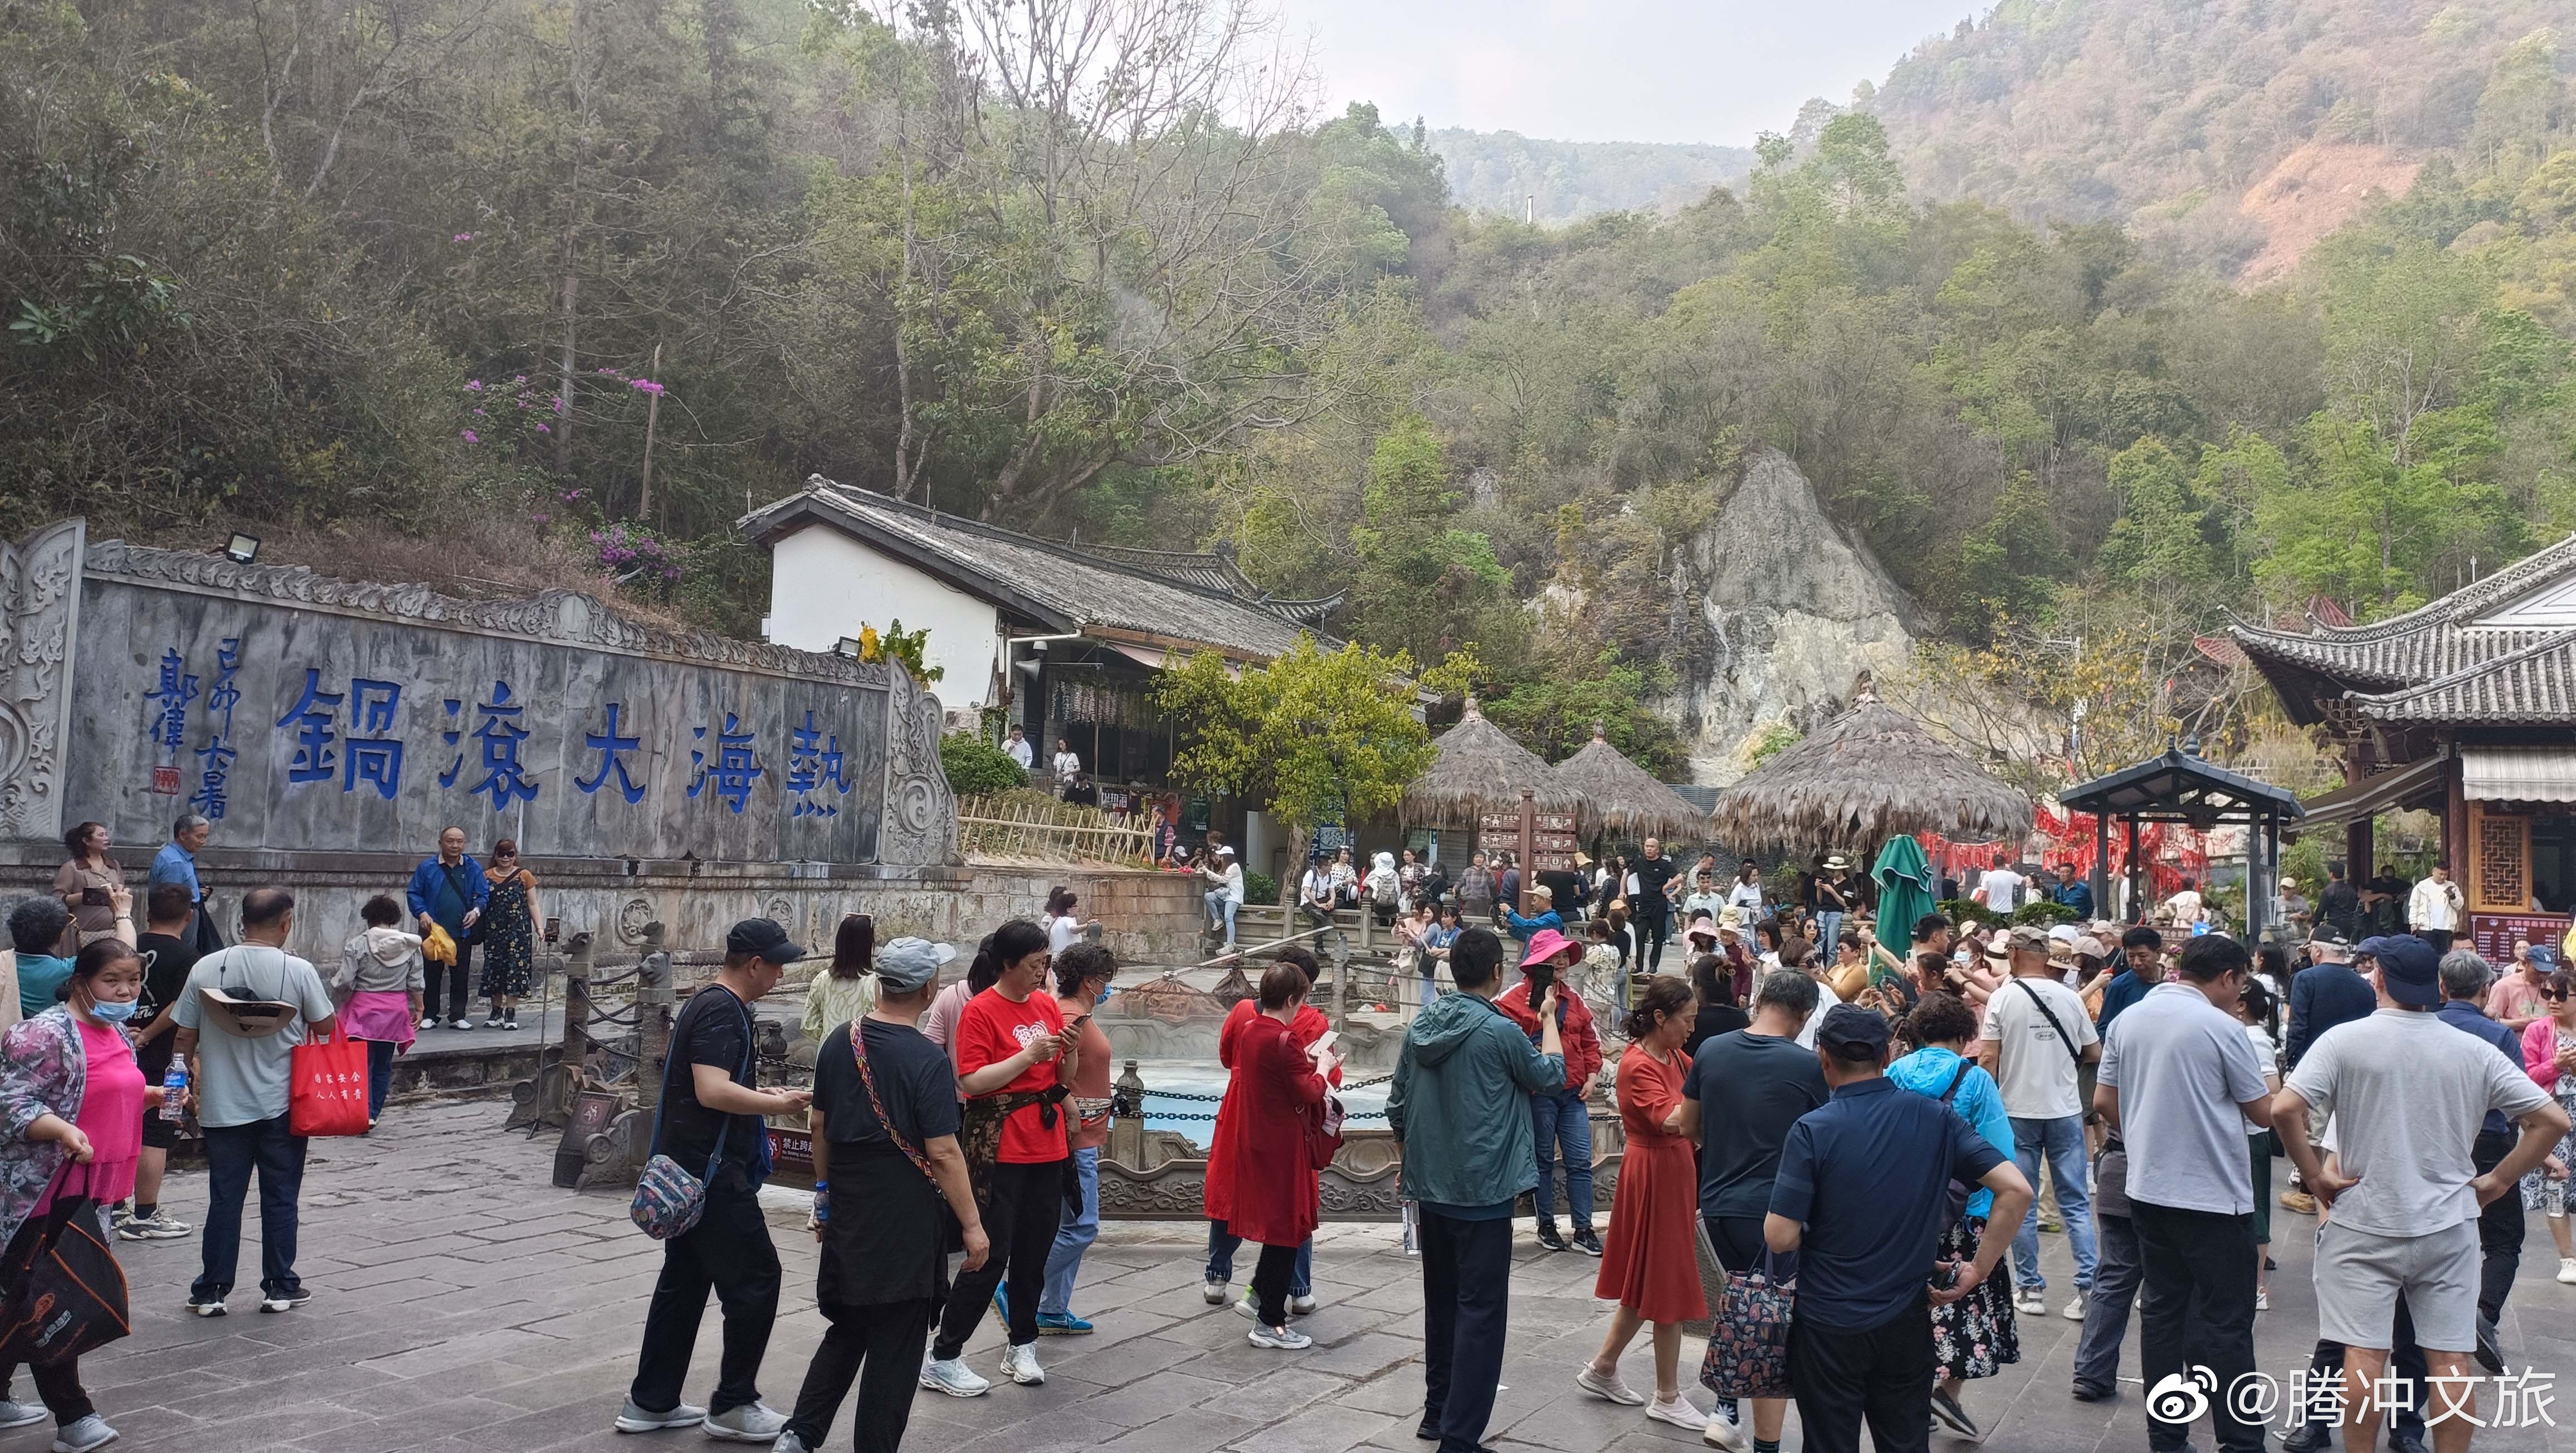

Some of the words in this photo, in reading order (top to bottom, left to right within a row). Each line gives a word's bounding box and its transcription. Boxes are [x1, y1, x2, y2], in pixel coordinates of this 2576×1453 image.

[315, 1071, 360, 1084] 国家安全
[316, 1088, 362, 1100] 人人有责
